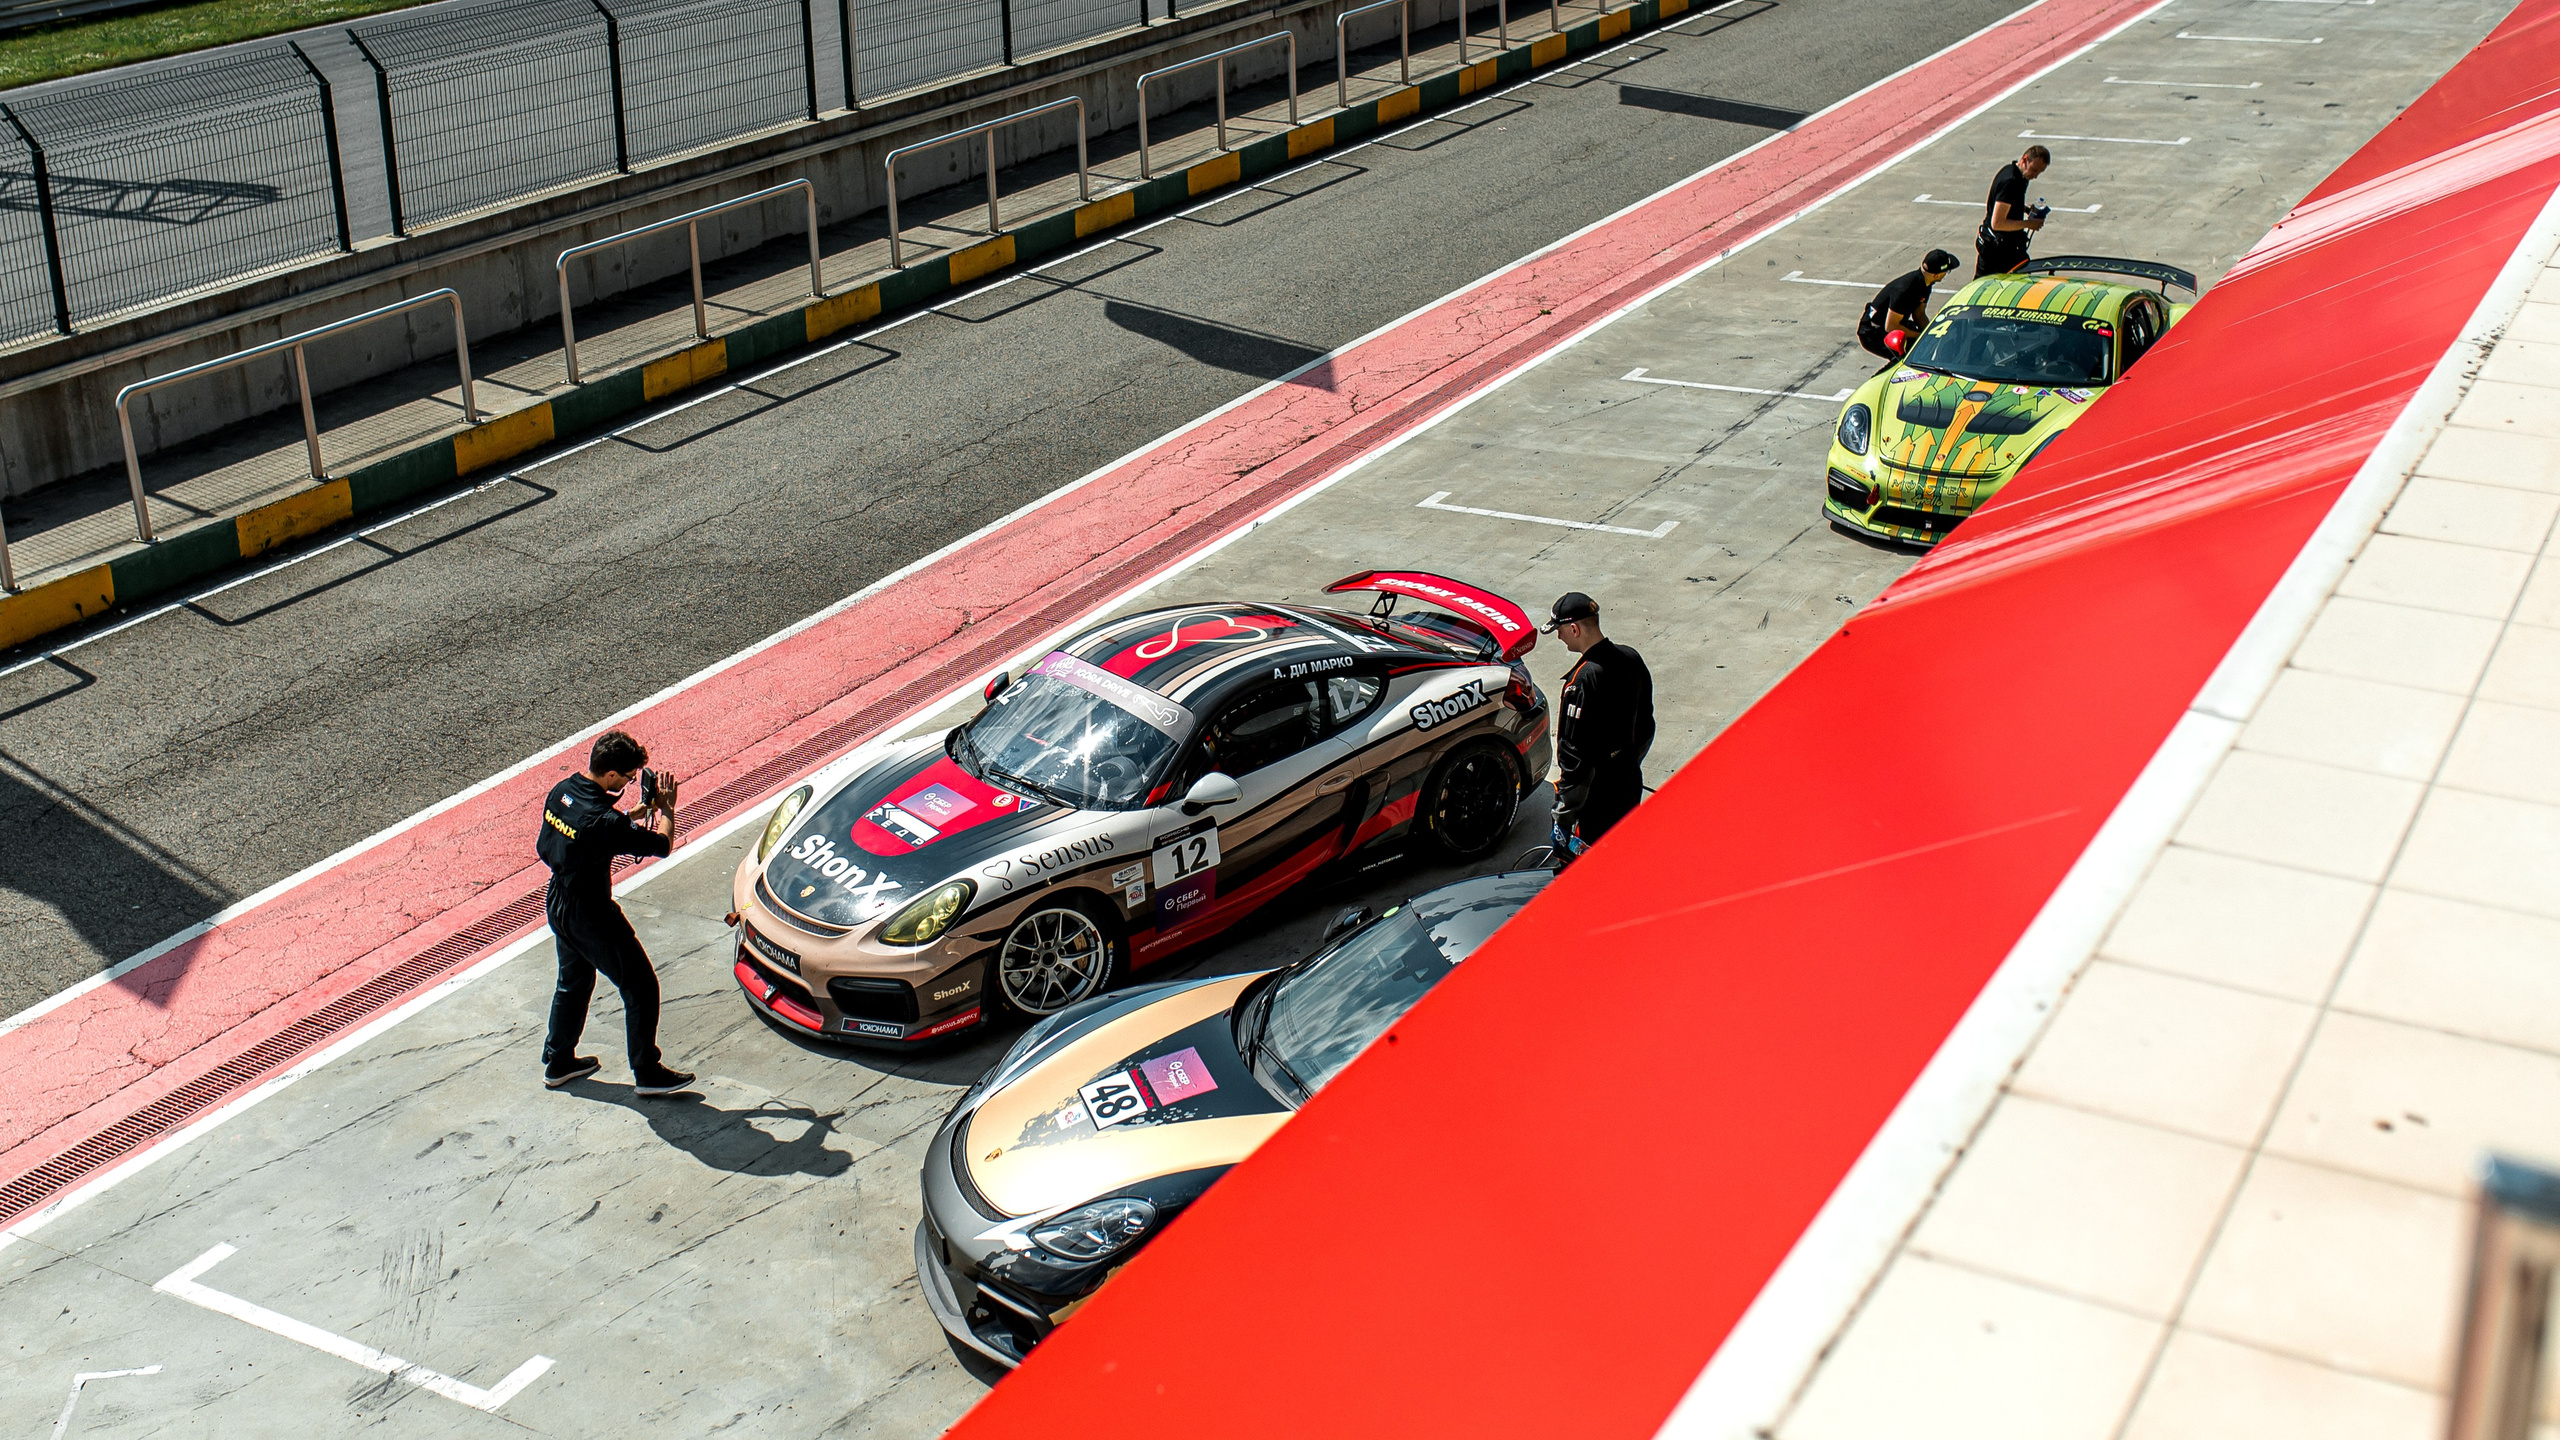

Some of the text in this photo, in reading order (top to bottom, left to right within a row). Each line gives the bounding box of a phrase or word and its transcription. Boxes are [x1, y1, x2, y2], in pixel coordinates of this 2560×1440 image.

[1928, 320, 1953, 338] 4
[1982, 307, 2067, 322] GRAN TURISMO
[1374, 578, 1521, 632] SHONX RACING
[1273, 656, 1353, 679] А. ДИ МАРКО
[1074, 668, 1133, 699] IGORA DRIVE
[1327, 679, 1367, 719] 12
[1413, 681, 1487, 729] ShonX
[545, 809, 577, 839] SHONX
[790, 834, 902, 903] ShonX
[1020, 831, 1115, 878] Sensus
[1171, 837, 1209, 879] 12
[1176, 889, 1199, 903] СБЕР
[1177, 893, 1206, 911] Первый
[755, 935, 797, 970] YOKOHAMA
[1140, 931, 1182, 953] agencysensus.com
[1100, 954, 1113, 990] MICHELIN
[933, 980, 970, 1001] ShonX
[859, 1023, 899, 1035] YOKOHAMA
[1090, 1083, 1138, 1119] 48
